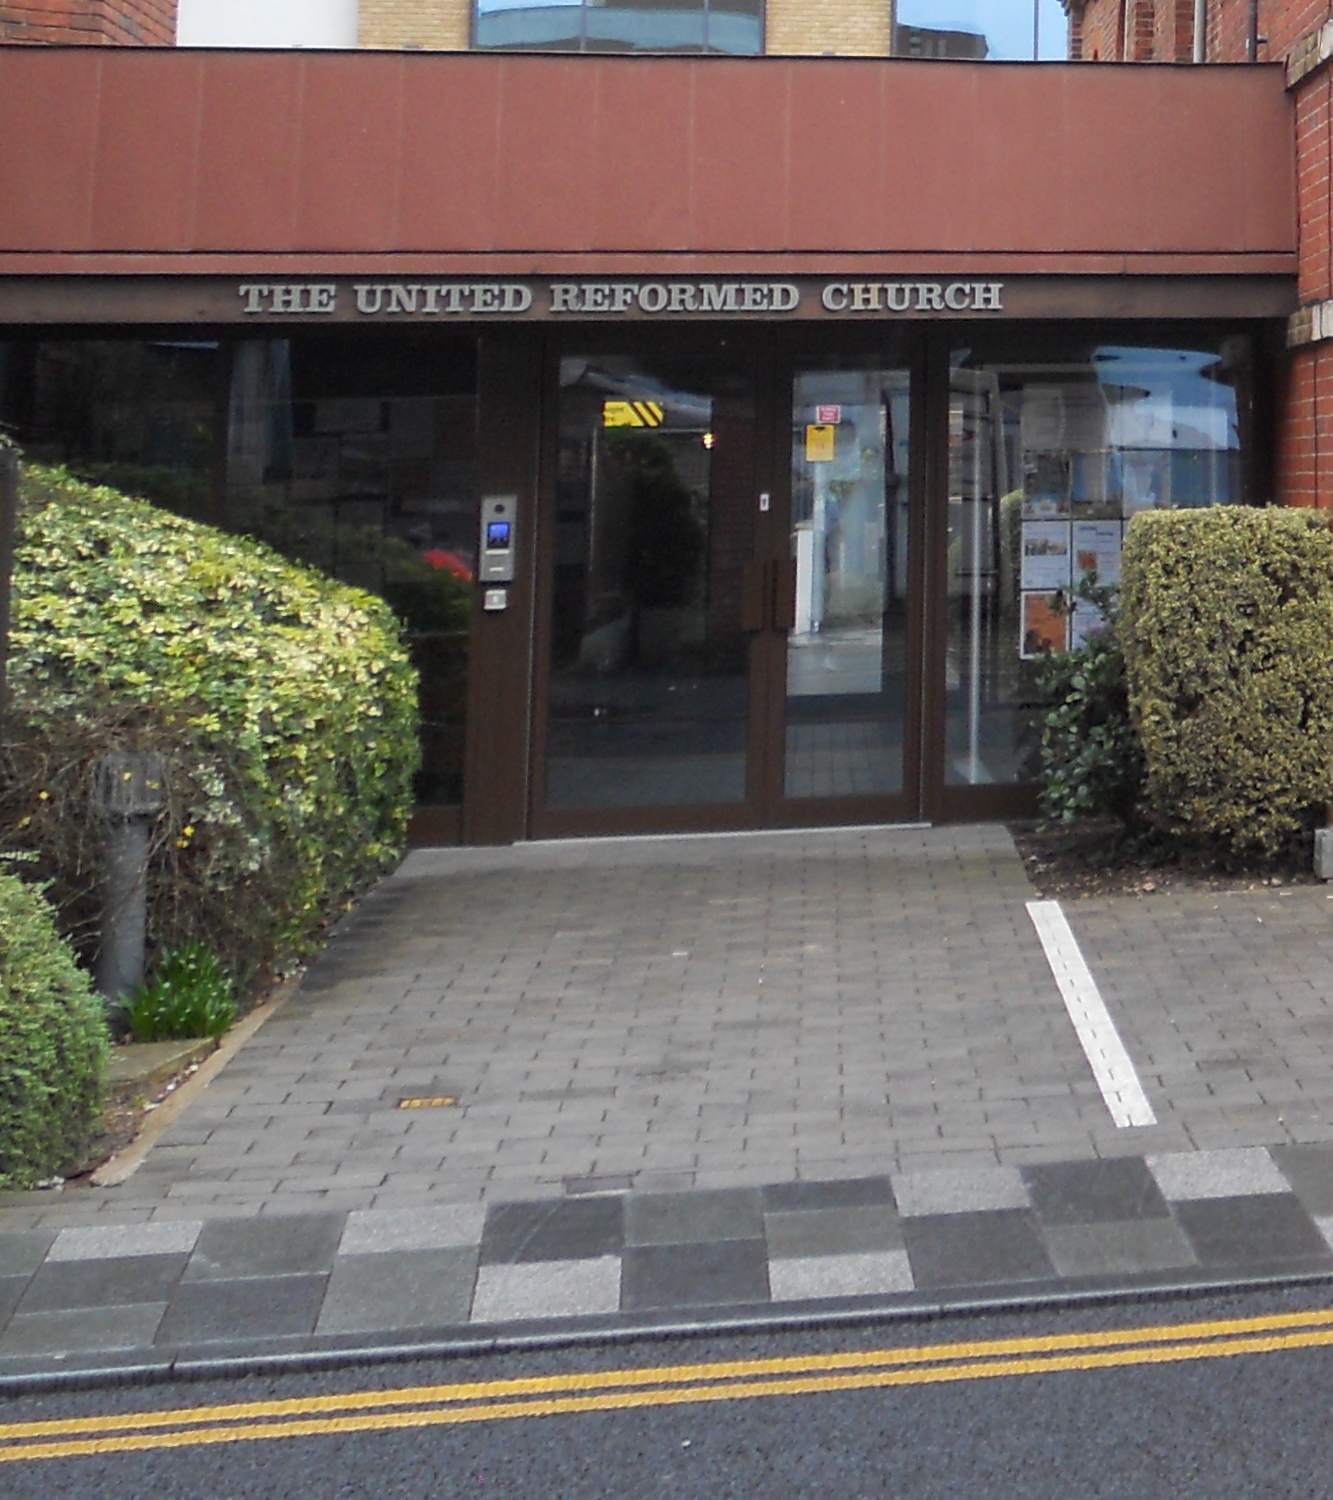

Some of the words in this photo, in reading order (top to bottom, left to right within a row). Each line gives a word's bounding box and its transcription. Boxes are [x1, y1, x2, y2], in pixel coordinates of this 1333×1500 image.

[239, 284, 336, 313] THE
[353, 284, 533, 314] UNITED
[549, 283, 800, 313] REFORMED
[821, 283, 1004, 311] CHURCH
